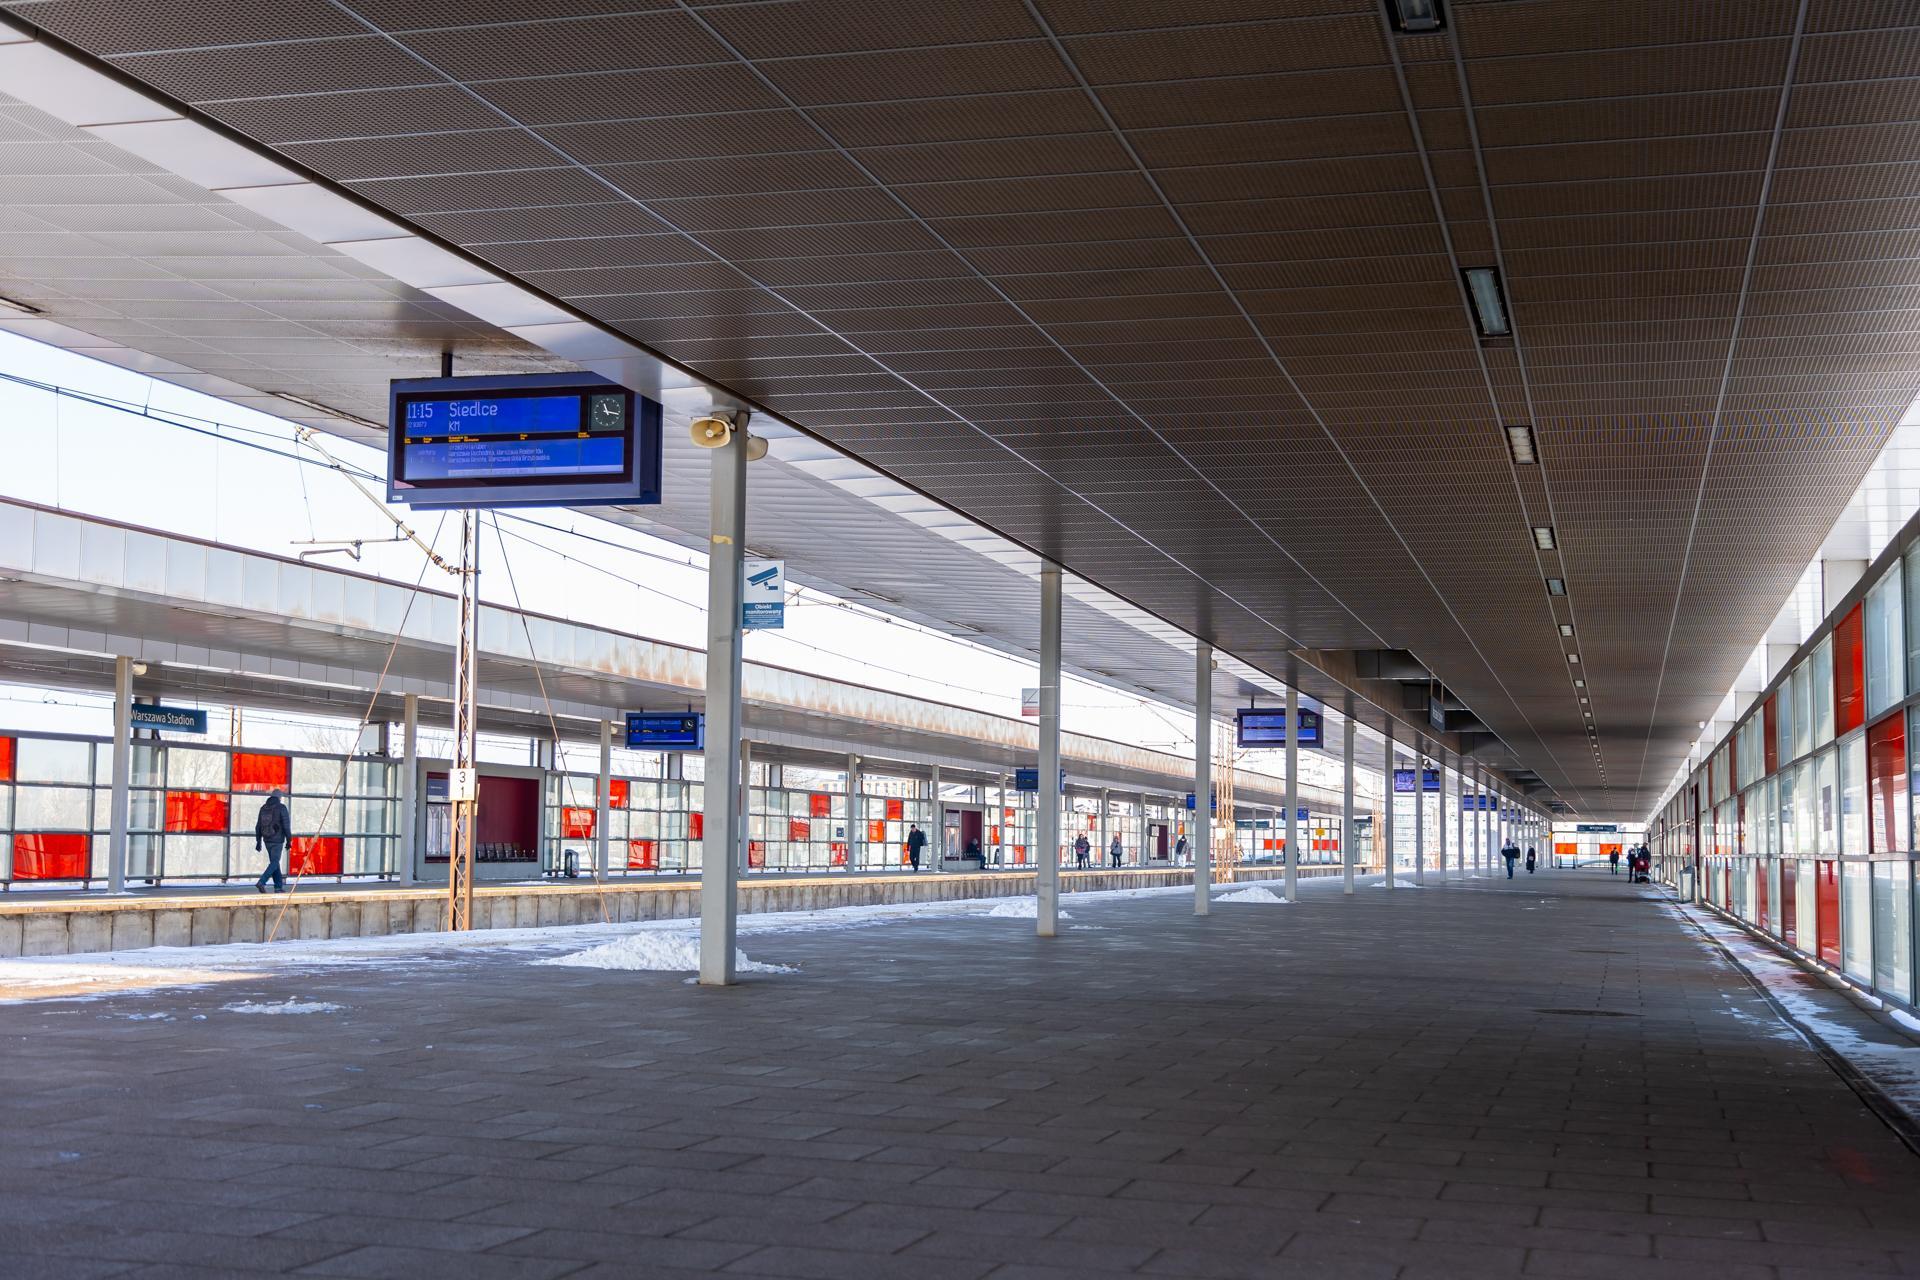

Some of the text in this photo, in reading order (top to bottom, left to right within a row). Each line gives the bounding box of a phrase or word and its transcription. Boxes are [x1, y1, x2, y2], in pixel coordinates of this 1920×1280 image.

[407, 401, 498, 419] 11:15 Siedlce
[448, 420, 461, 432] KM
[167, 712, 195, 726] Stadion
[459, 771, 466, 783] 3
[460, 786, 465, 798] 1
